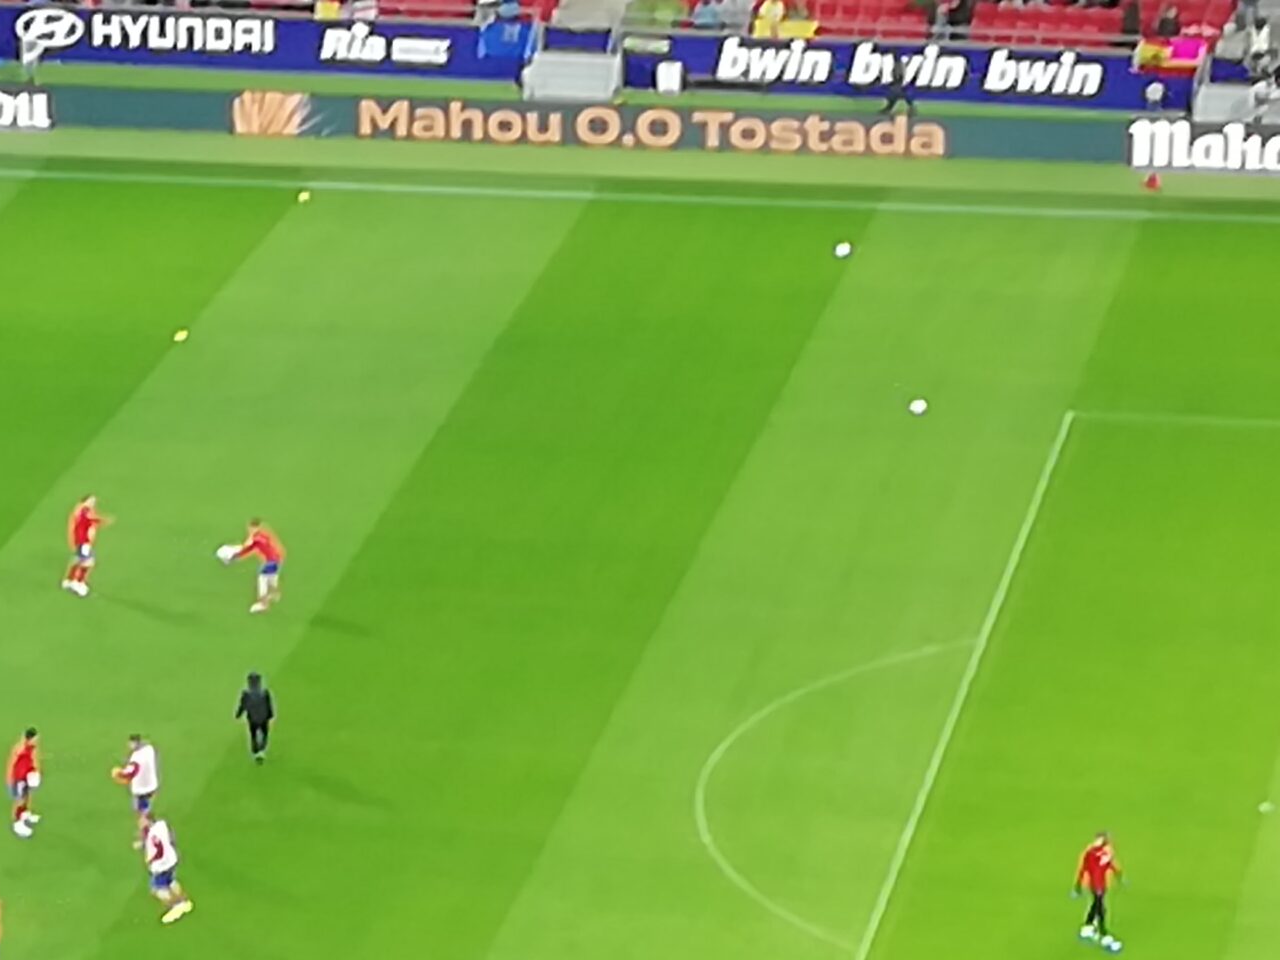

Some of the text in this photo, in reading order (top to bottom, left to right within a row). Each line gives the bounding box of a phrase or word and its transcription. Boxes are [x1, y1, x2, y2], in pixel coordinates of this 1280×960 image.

[92, 13, 276, 54] HYUNDAI
[716, 36, 832, 82] bwin
[984, 49, 1104, 96] bwin
[358, 98, 562, 142] Mahou
[691, 110, 946, 157] Tostada
